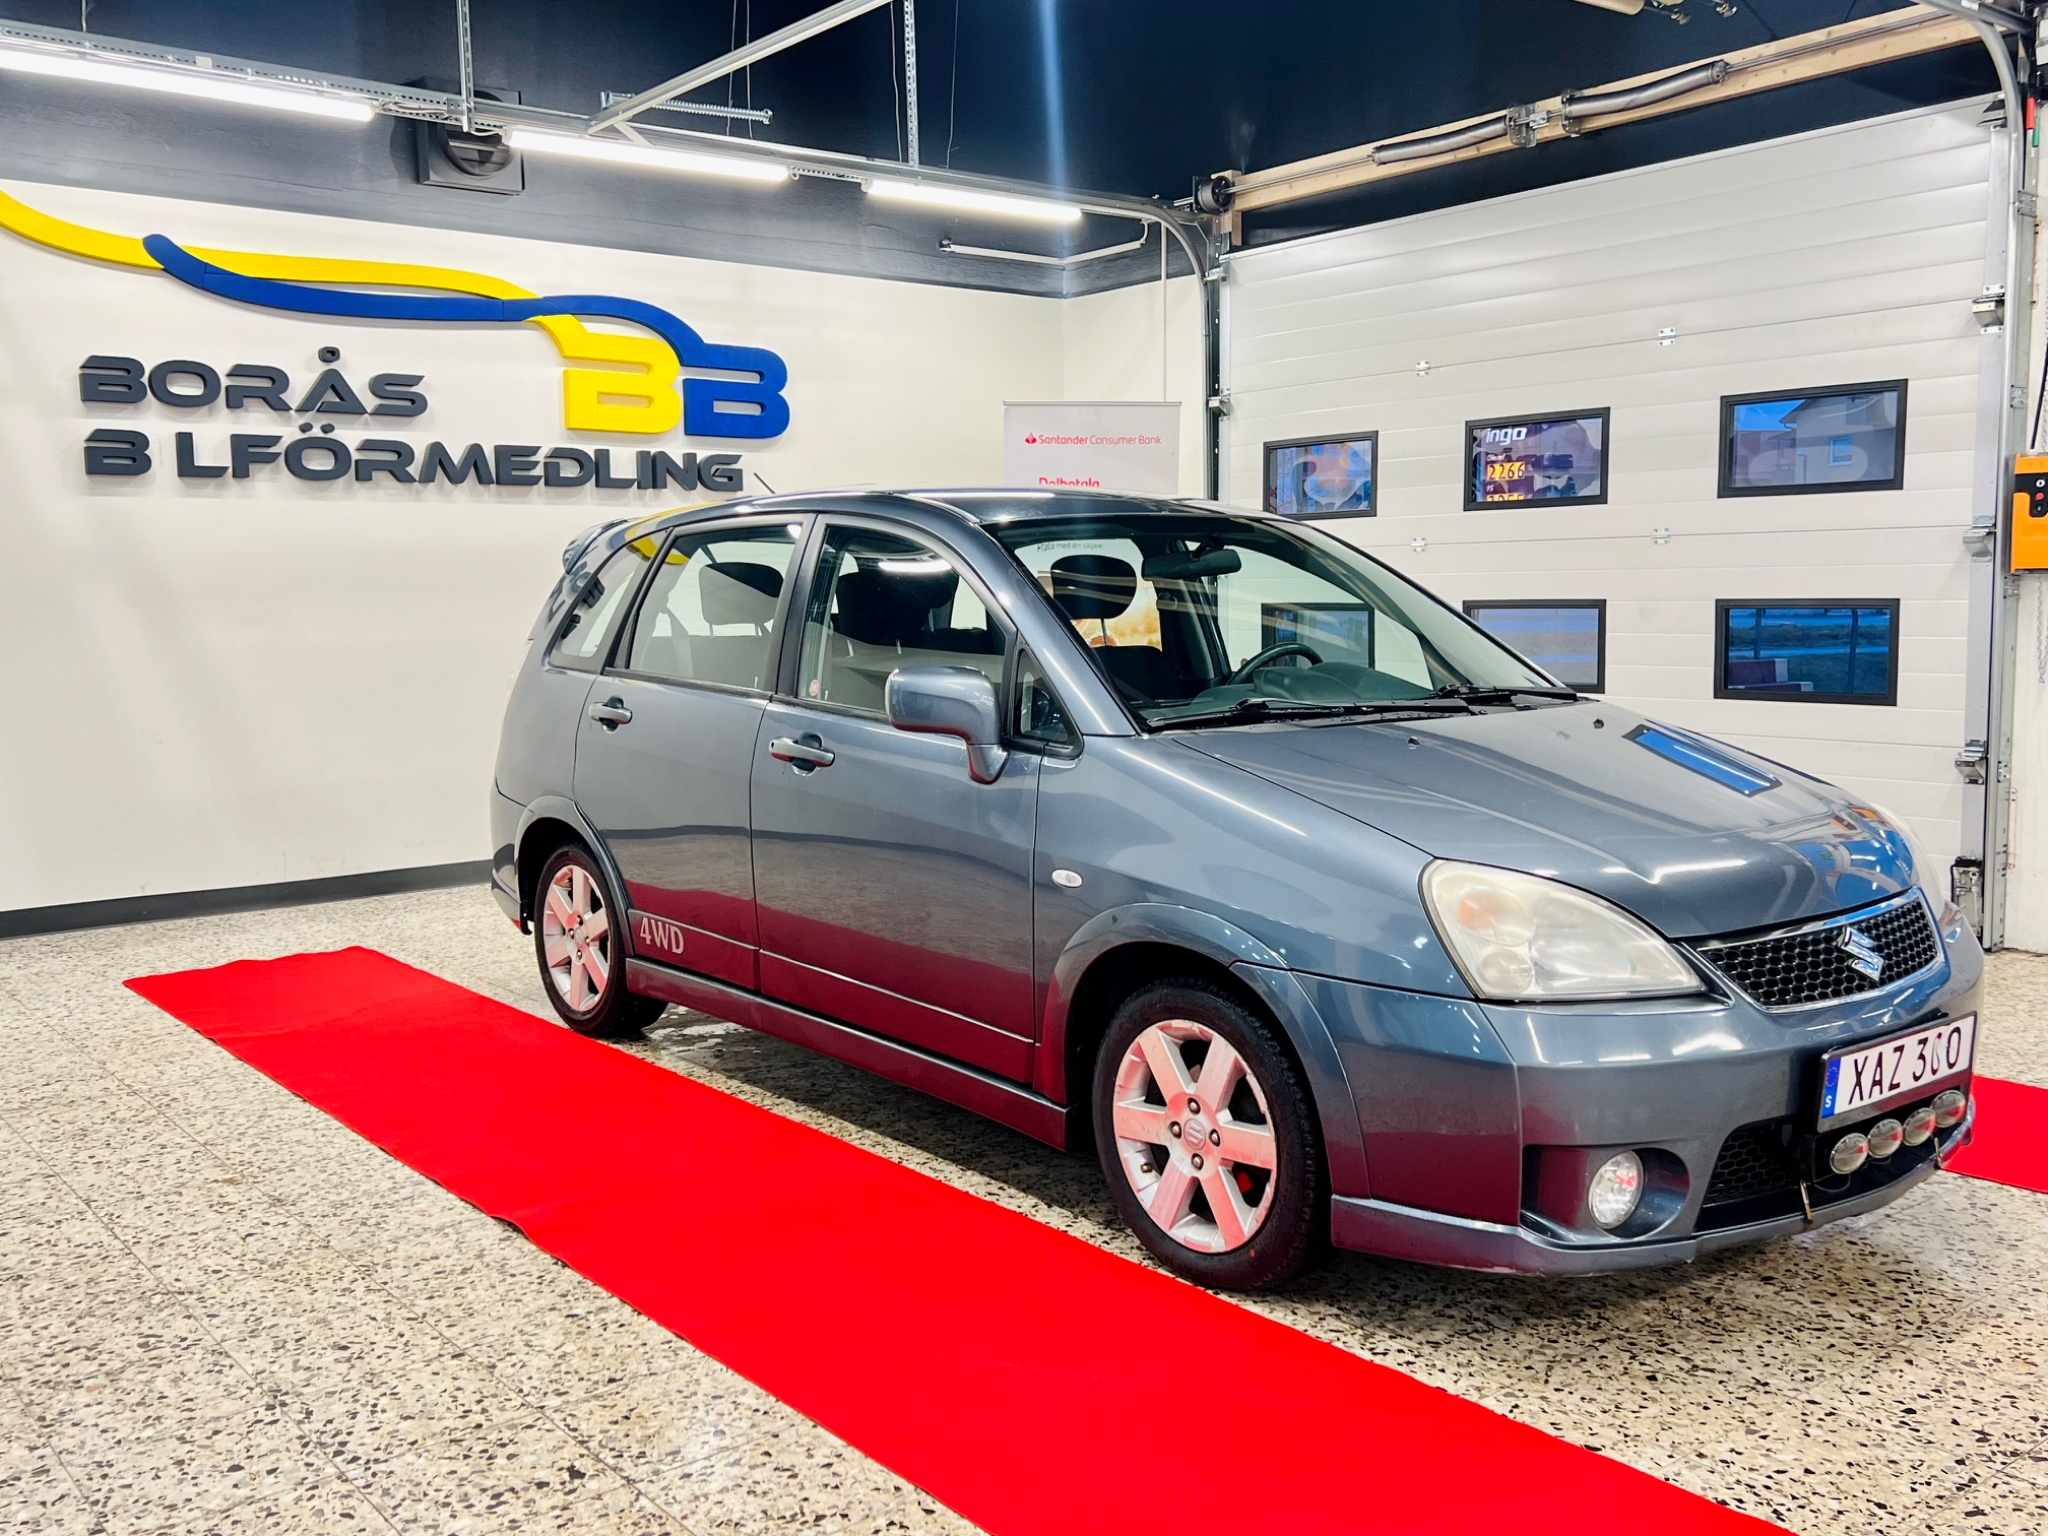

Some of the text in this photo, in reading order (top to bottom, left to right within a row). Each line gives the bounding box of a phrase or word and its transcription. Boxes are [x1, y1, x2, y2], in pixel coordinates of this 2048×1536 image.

[79, 346, 428, 417] BORÅS
[1039, 434, 1162, 445] Santander Consumer Bank
[1486, 427, 1527, 446] ingo
[1488, 463, 1525, 479] 2266
[640, 917, 684, 954] 4WD
[1848, 1044, 1905, 1105] XAZ
[1825, 1095, 1832, 1108] S
